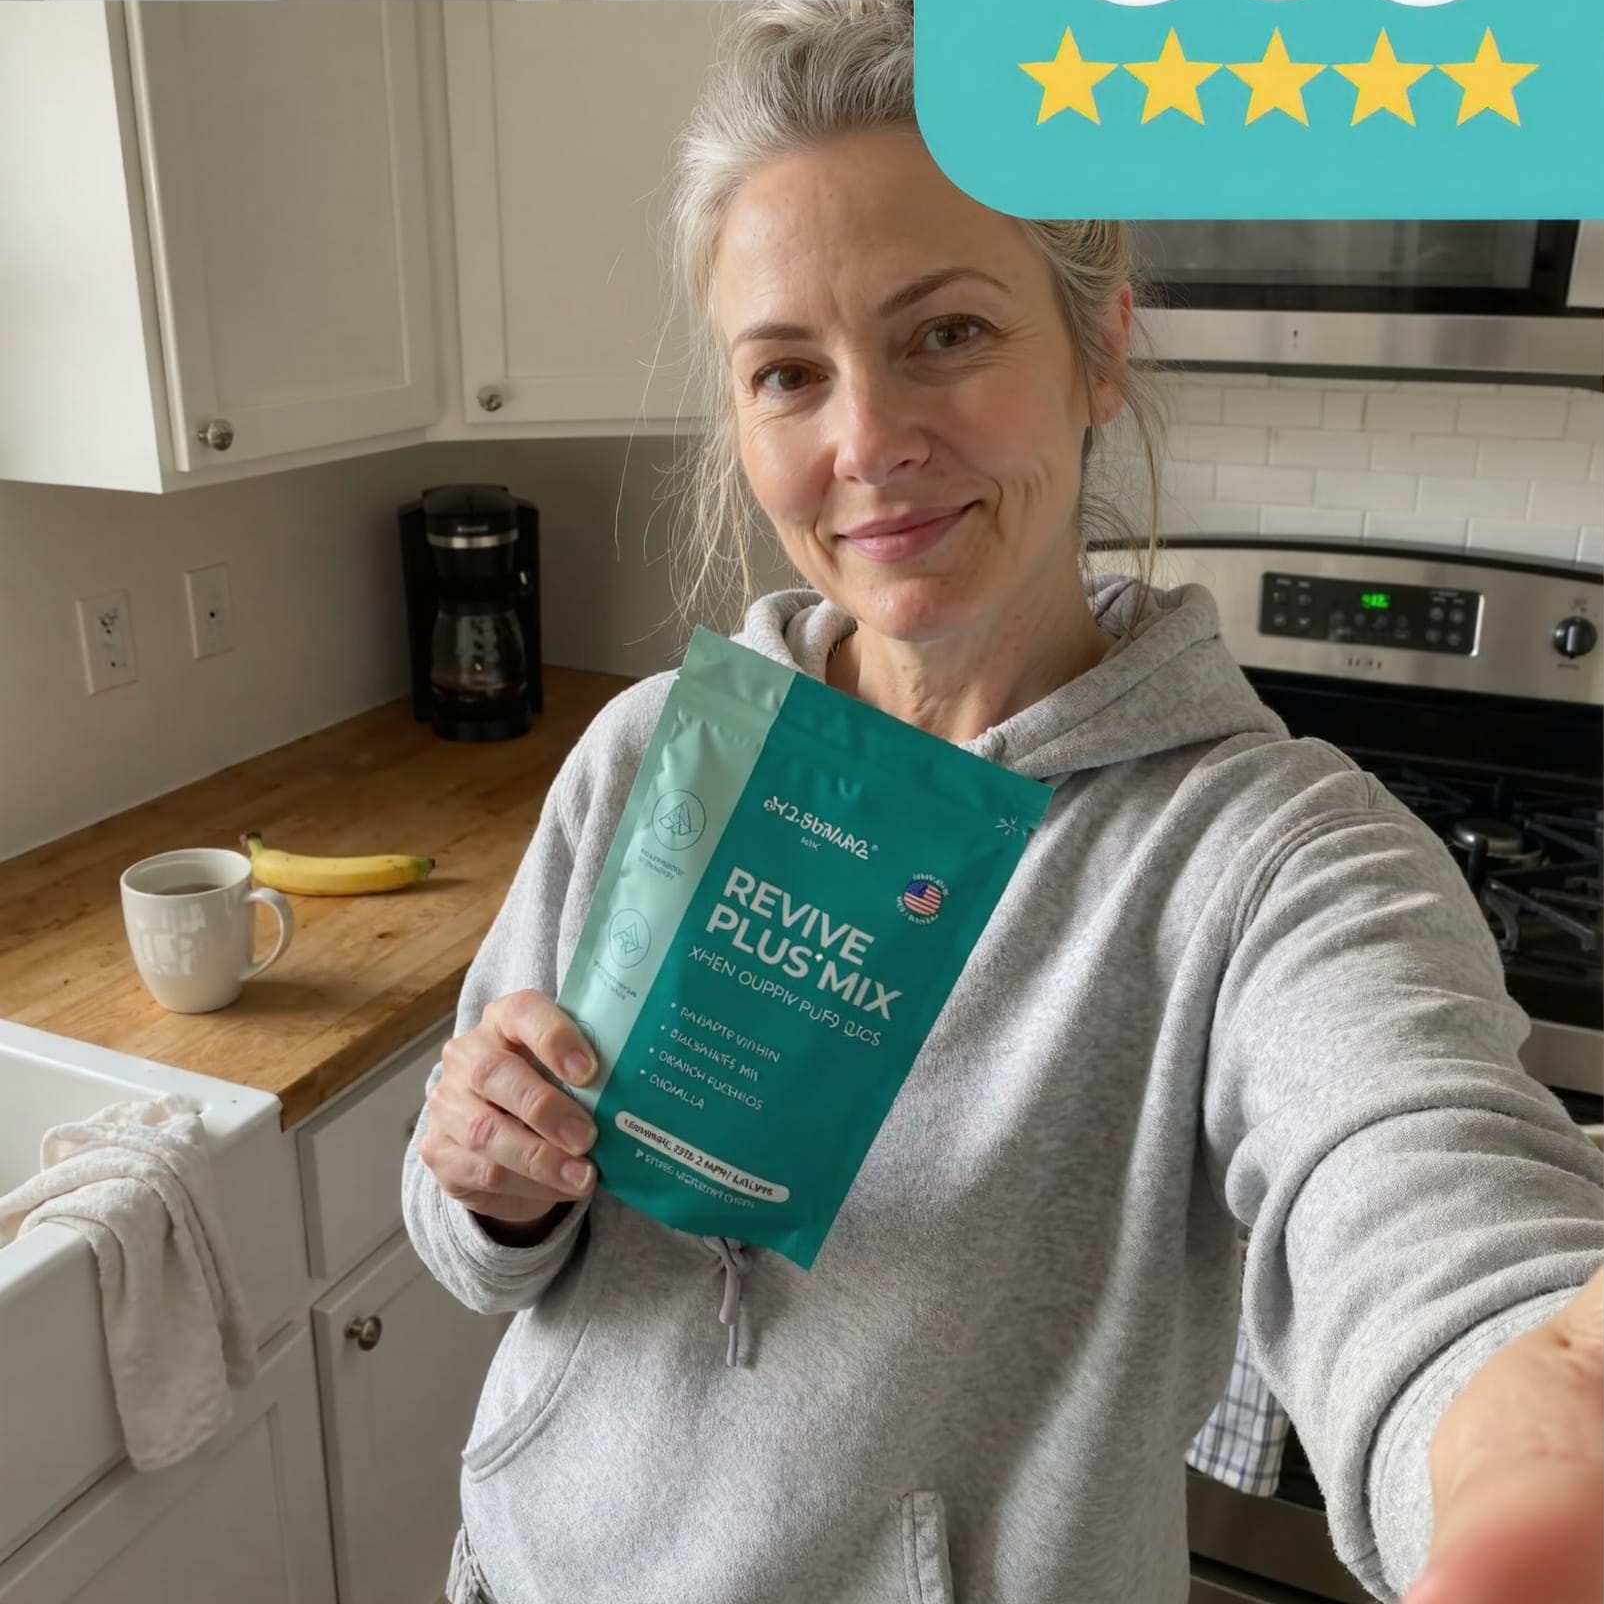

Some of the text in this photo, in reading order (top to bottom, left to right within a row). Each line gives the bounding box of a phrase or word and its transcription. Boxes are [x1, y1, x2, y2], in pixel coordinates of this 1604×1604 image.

[705, 903, 903, 1021] PLUS MIX
[723, 867, 875, 967] REVIVE
